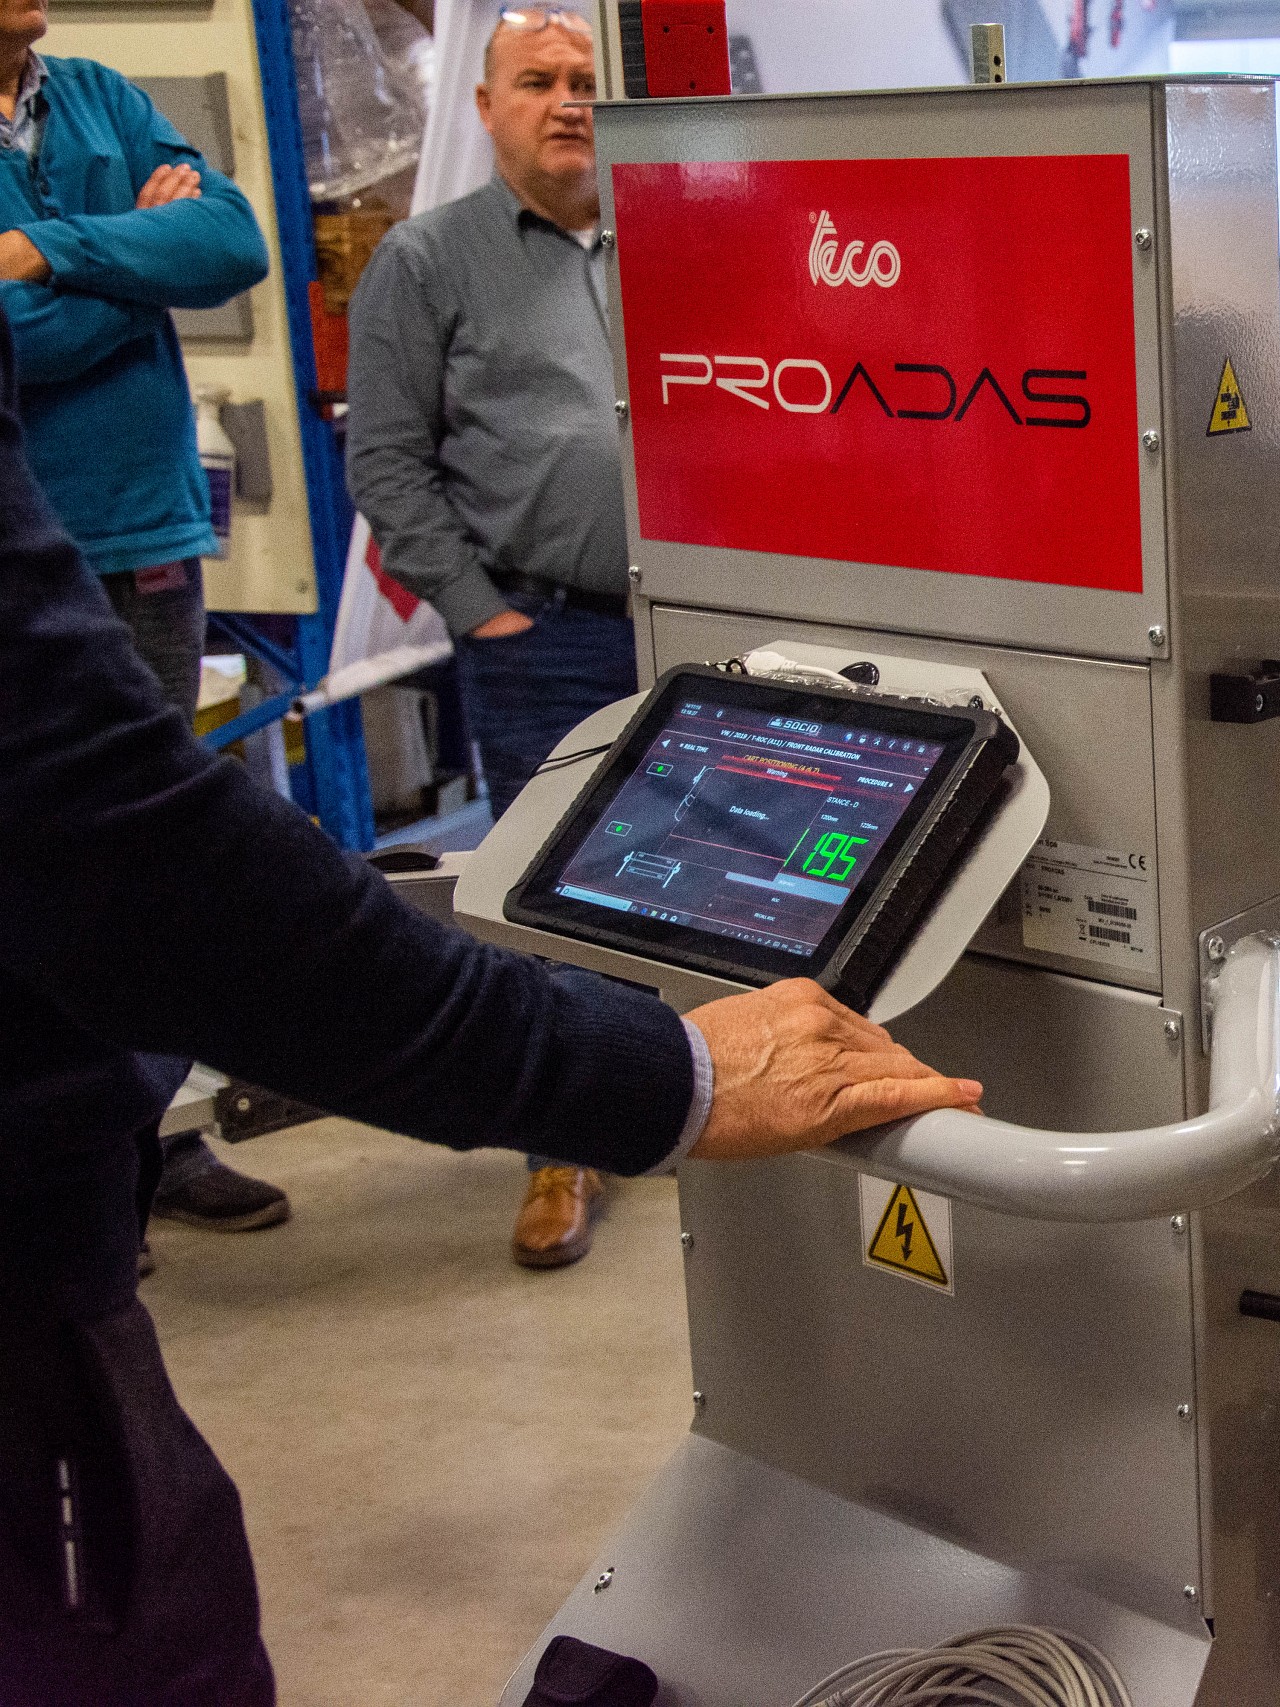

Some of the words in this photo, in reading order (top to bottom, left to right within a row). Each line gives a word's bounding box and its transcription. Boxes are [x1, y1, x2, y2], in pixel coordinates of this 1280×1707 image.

[808, 209, 901, 288] teco
[660, 353, 1091, 429] PROADAS
[783, 720, 819, 733] SOCIO
[684, 743, 696, 751] REAL
[695, 745, 709, 753] TIME
[733, 731, 748, 740] 2019
[751, 735, 769, 743] T-ROC
[766, 738, 782, 748] (A11)
[786, 741, 806, 751] FRONT
[804, 744, 823, 754] RADAR
[823, 748, 861, 760] CALIBRATION
[766, 768, 788, 778] Warning
[857, 776, 889, 787] PROCEDURE
[826, 797, 851, 807] STANCE
[729, 805, 744, 814] Data
